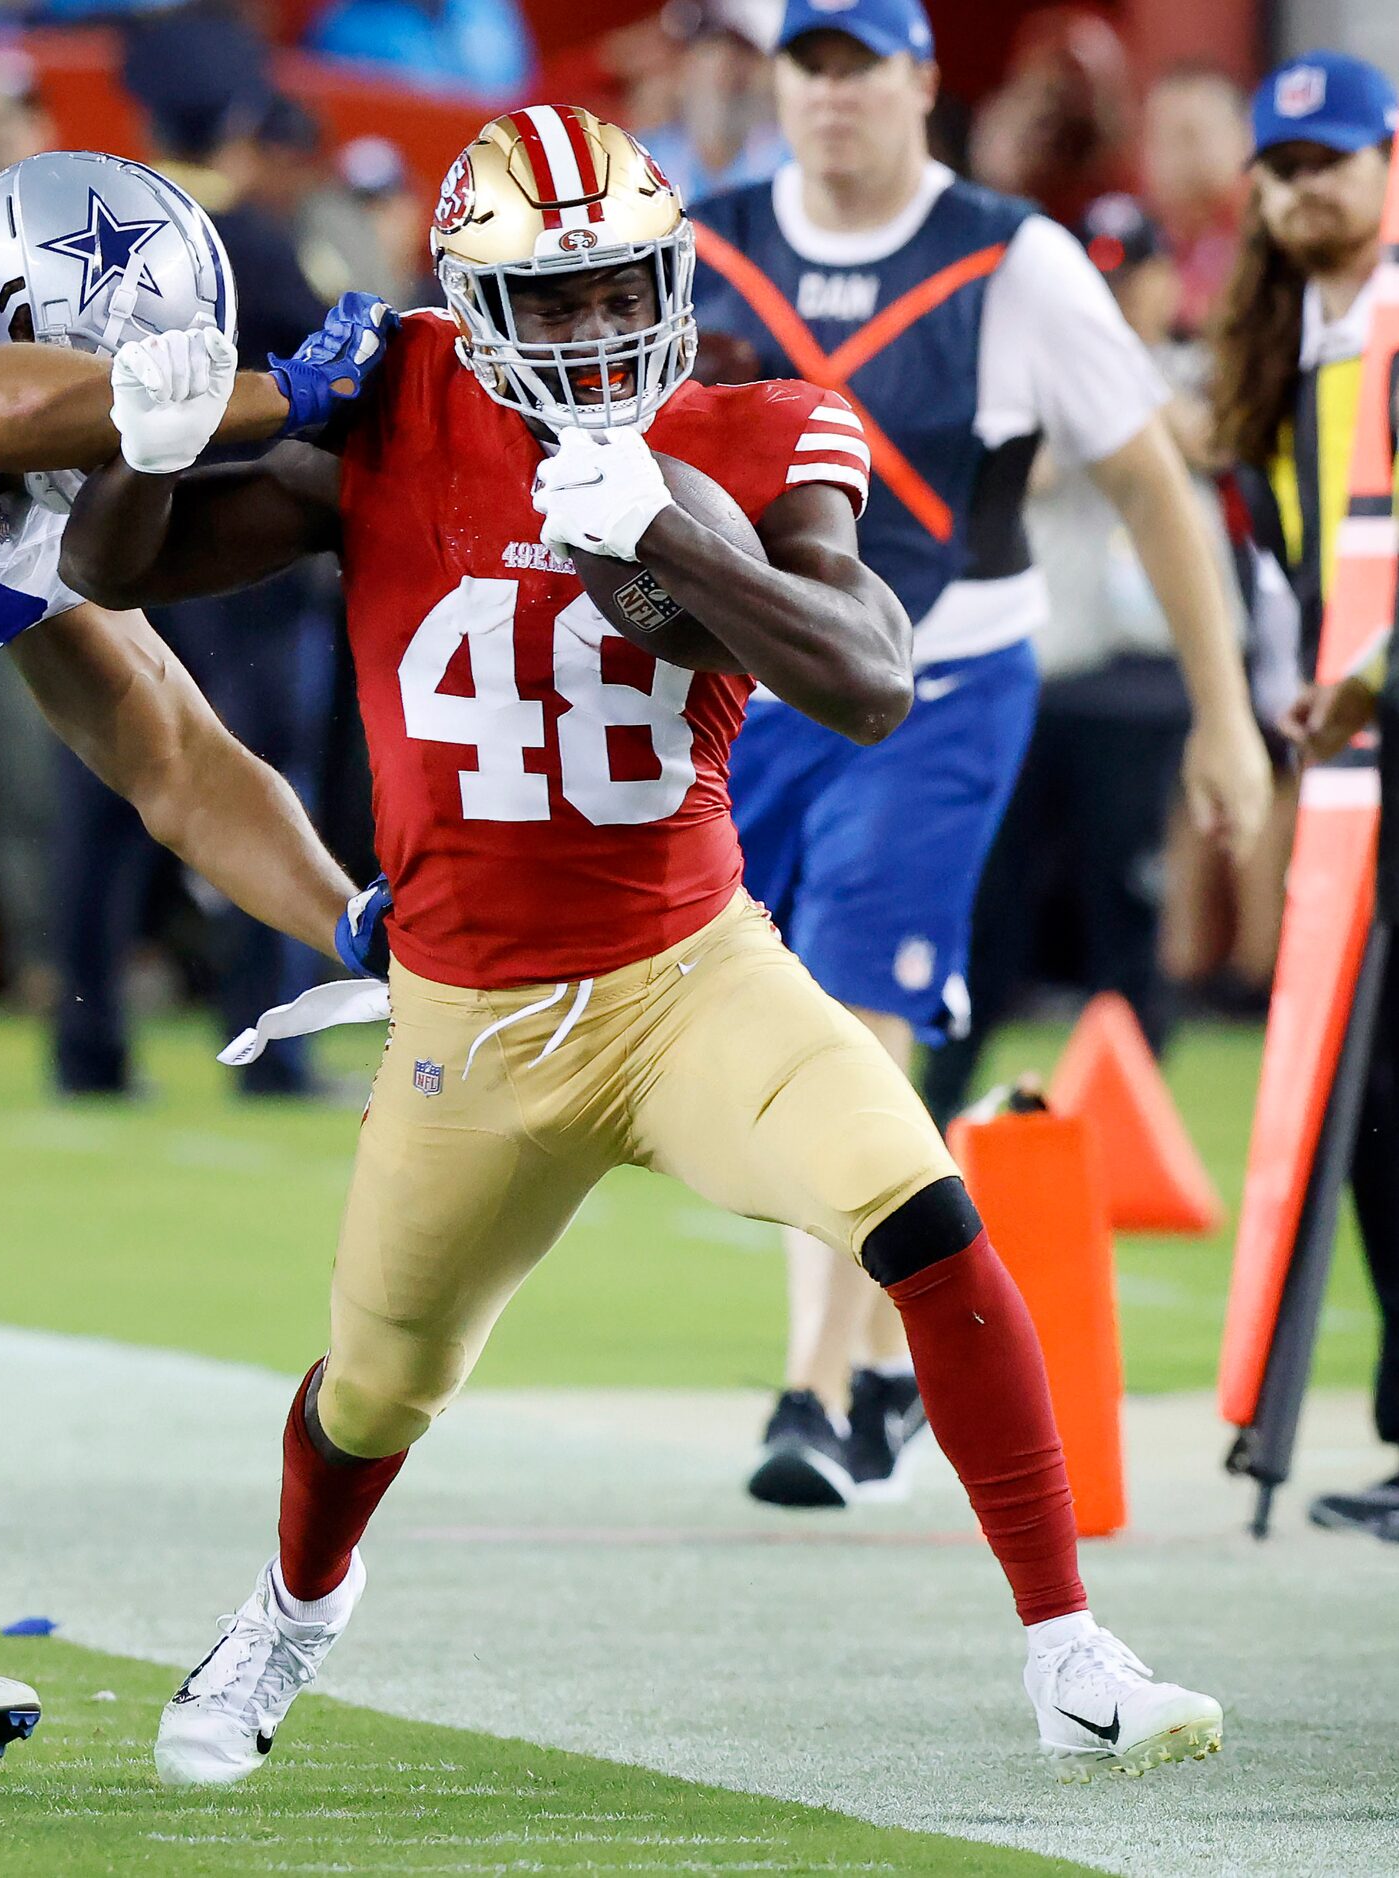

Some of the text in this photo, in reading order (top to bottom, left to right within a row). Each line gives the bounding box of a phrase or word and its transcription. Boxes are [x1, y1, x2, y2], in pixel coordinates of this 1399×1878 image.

[619, 587, 660, 627] NFL
[396, 574, 697, 827] 48
[417, 1073, 437, 1090] NFL
